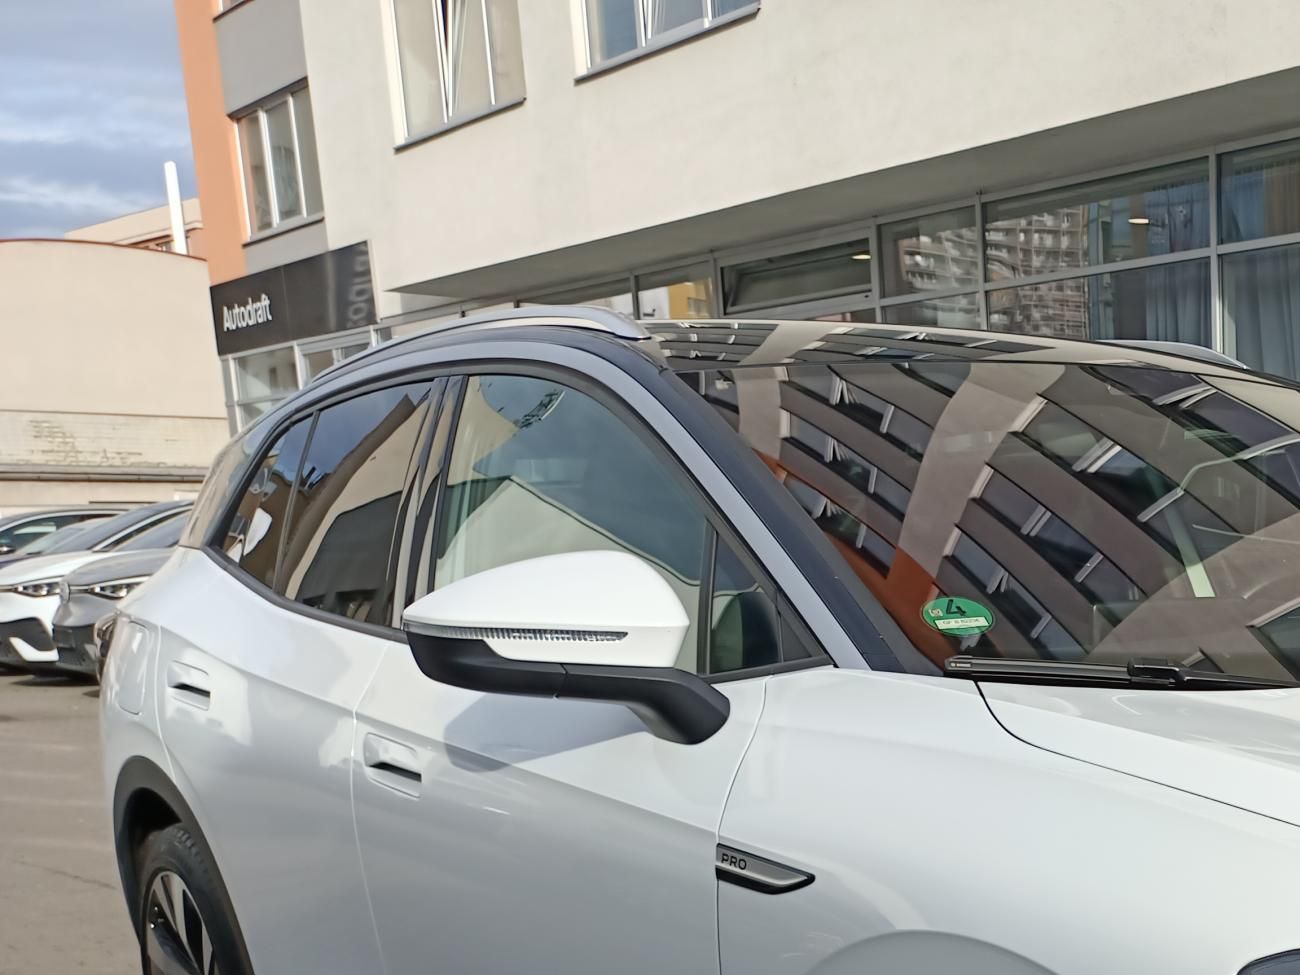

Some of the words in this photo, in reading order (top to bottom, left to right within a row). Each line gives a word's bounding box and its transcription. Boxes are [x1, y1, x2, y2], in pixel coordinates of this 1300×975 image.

[223, 293, 273, 332] Autodraft
[945, 598, 967, 617] 4
[720, 853, 747, 871] PRO
